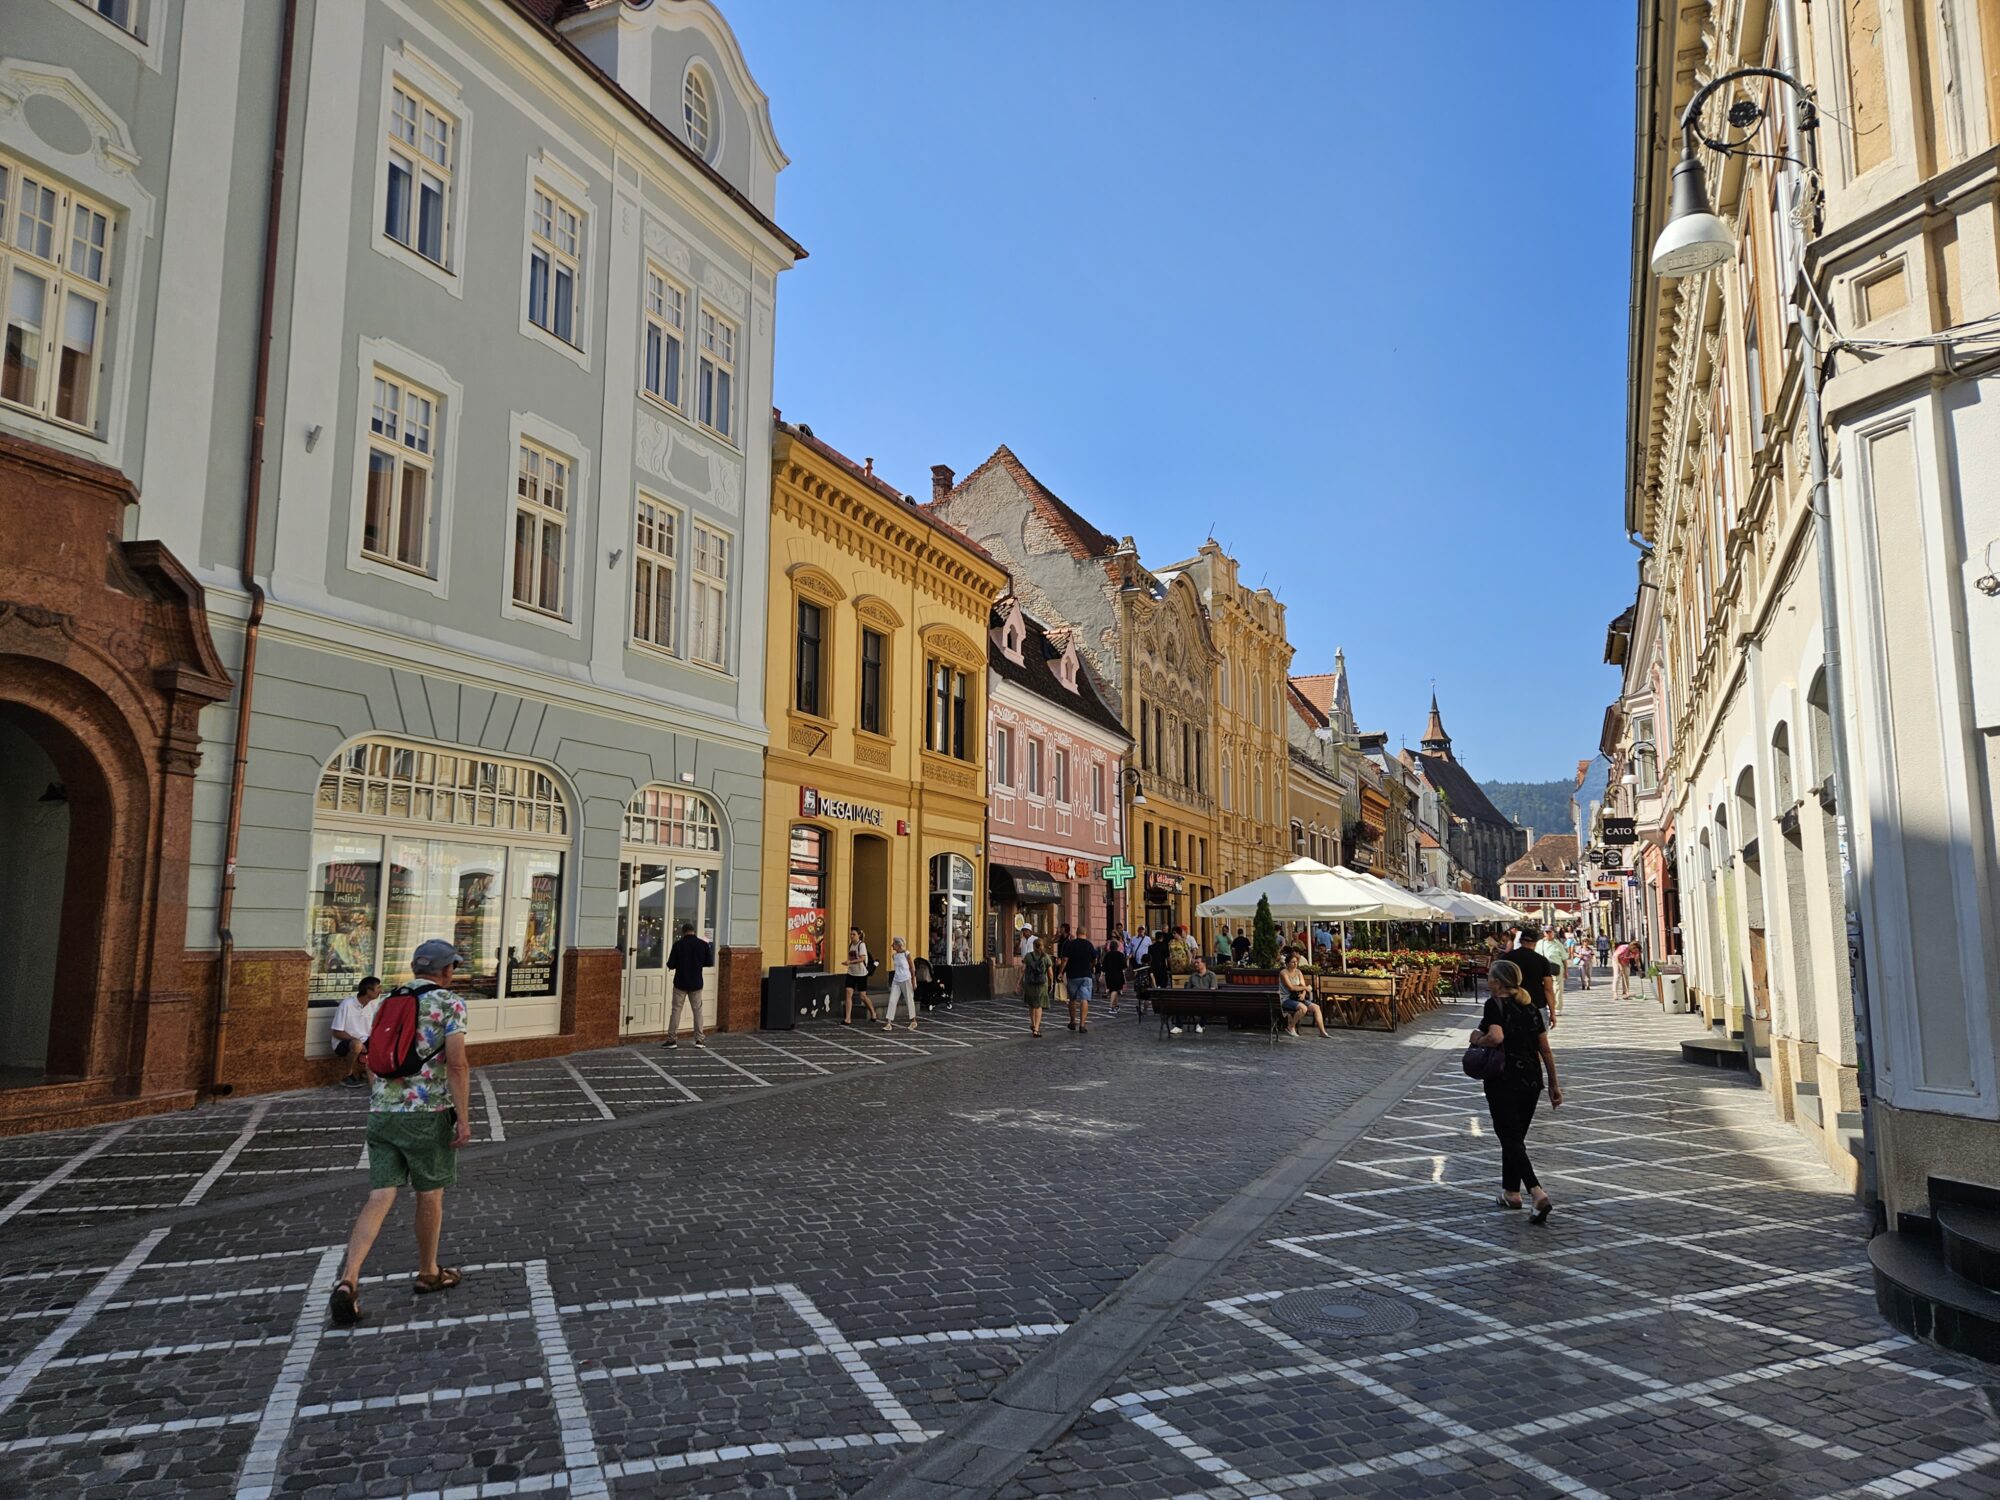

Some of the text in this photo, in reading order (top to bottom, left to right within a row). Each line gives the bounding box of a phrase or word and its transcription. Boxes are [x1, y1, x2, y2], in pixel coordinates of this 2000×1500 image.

[1606, 827, 1632, 835] CATO
[1598, 873, 1615, 882] dm
[335, 878, 366, 894] blues
[333, 893, 361, 904] Festival
[787, 911, 816, 930] ROMO
